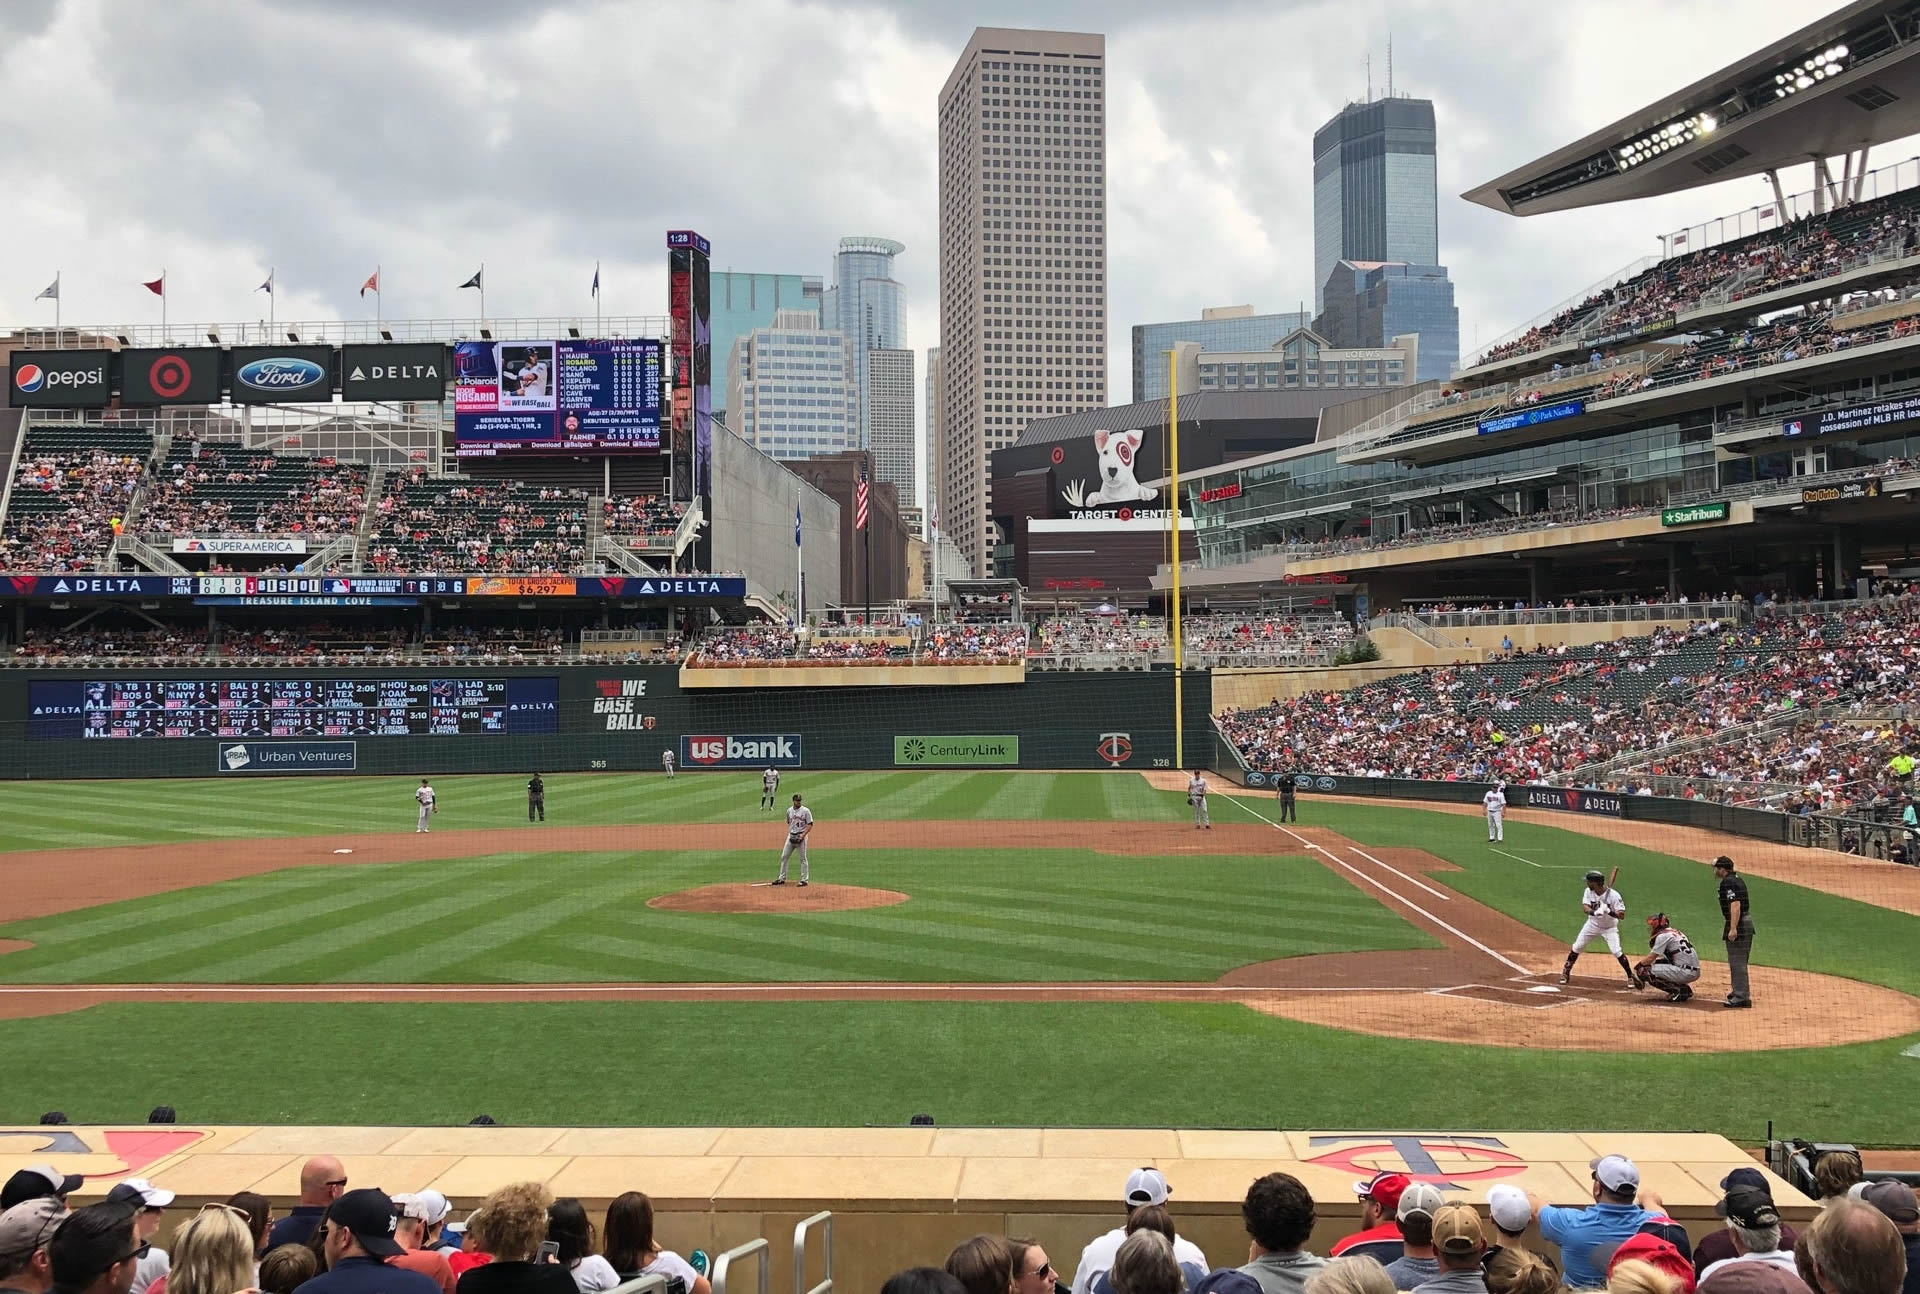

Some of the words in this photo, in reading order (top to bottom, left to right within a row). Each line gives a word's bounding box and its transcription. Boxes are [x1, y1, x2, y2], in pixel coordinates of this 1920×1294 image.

[670, 234, 688, 243] 1:28
[1345, 350, 1380, 358] LOEWS
[255, 362, 306, 385] Ford
[371, 365, 438, 379] DELTA
[47, 367, 103, 389] pepsi
[464, 377, 498, 385] Polaroid
[456, 392, 496, 402] ROSARIO
[1481, 420, 1497, 428] CLOSED
[1540, 412, 1553, 420] Park
[1553, 406, 1574, 417] Nicollet
[1821, 413, 1836, 422] J.D.
[1838, 407, 1872, 420] Martinez
[1874, 402, 1903, 413] retakes
[1820, 419, 1862, 434] possession
[1864, 417, 1872, 426] of
[1873, 414, 1891, 424] MLB
[1893, 411, 1905, 420] HR
[1844, 484, 1861, 492] Quality
[1804, 490, 1817, 502] Old
[1818, 488, 1840, 501] Dutch
[1070, 510, 1118, 519] TARGET
[1675, 509, 1722, 522] StarTribune
[209, 542, 293, 552] SUPERAMERICA
[76, 580, 141, 592] DELTA
[172, 578, 192, 586] DET
[420, 581, 428, 592] 6
[454, 581, 462, 592] 6
[660, 582, 720, 592] DELTA
[519, 586, 557, 595] $6,297
[240, 597, 293, 605] TREASURE
[300, 597, 338, 605] ISLAND
[345, 597, 372, 605] COVE
[623, 680, 646, 696] WE
[85, 700, 111, 710] A.L.
[433, 697, 453, 706] I.L.
[593, 697, 635, 713] BASE
[606, 714, 644, 730] BALL
[85, 728, 111, 737] N.L.
[930, 744, 1005, 758] CenturyLink
[260, 752, 296, 762] Urban
[299, 752, 352, 761] Ventures
[1536, 793, 1560, 804] DELTA
[1594, 800, 1620, 811] DELTA
